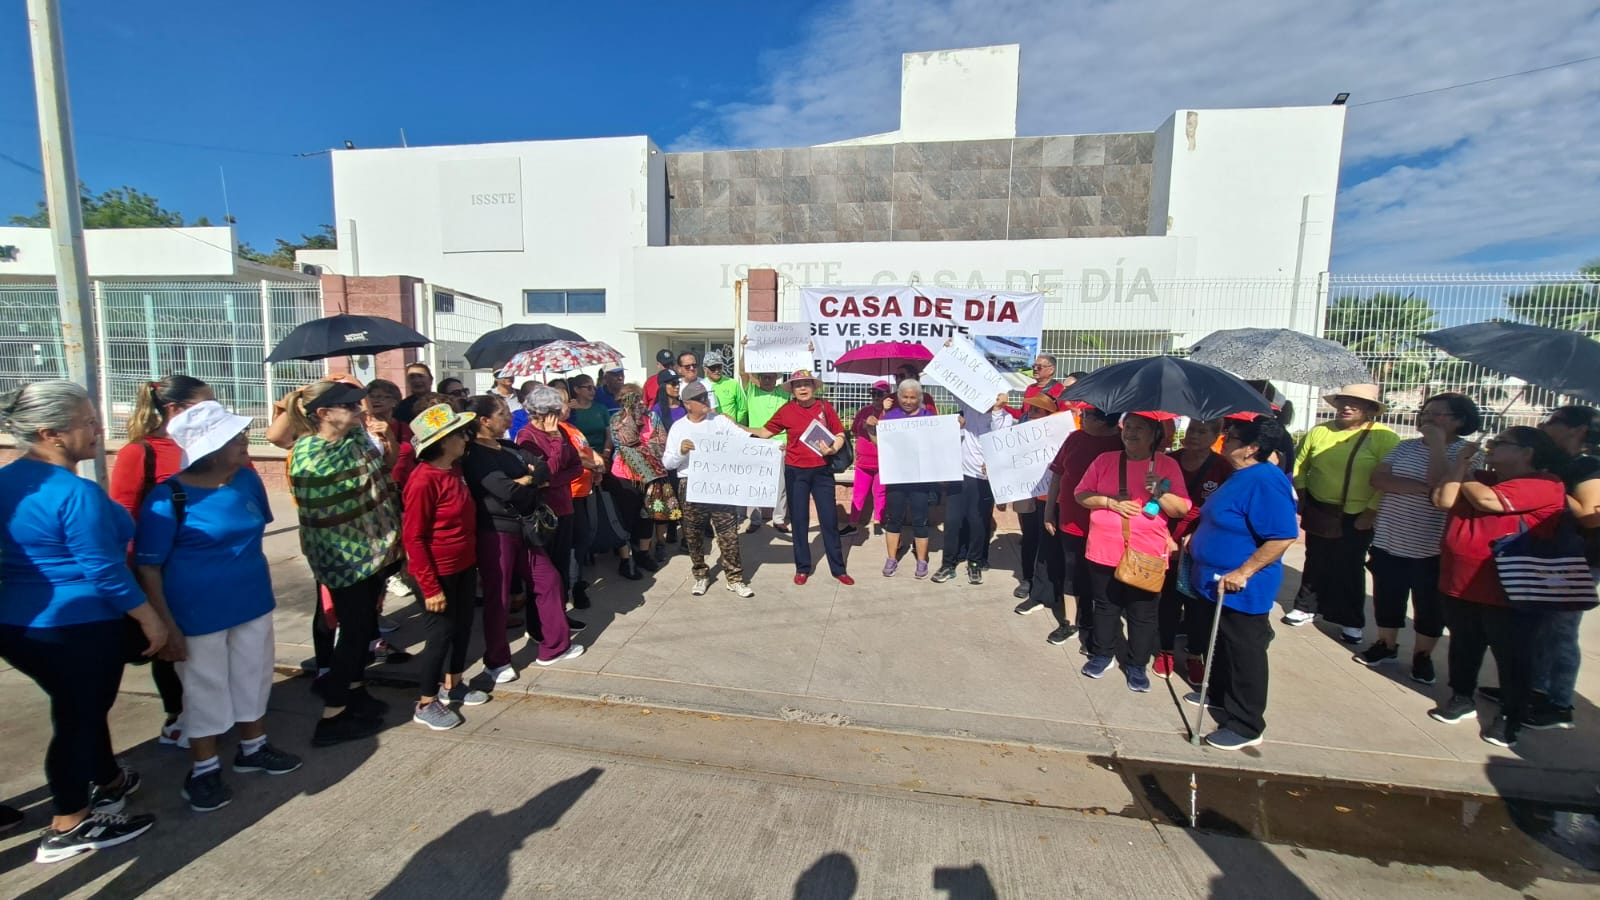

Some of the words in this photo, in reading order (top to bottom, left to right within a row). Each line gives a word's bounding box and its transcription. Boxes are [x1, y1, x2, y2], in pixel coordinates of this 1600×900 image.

[471, 192, 516, 206] ISSSTE
[1080, 258, 1160, 303] DÍA
[819, 295, 903, 318] CASA
[913, 296, 953, 320] DE
[964, 295, 1019, 323] DÍA
[867, 322, 892, 336] SE
[967, 358, 983, 373] DE
[992, 421, 1054, 452] DÓNDE
[693, 460, 753, 475] PASANDO
[759, 464, 773, 476] EN
[691, 481, 722, 496] CASA
[728, 482, 741, 496] DE
[993, 484, 1014, 498] LOS
